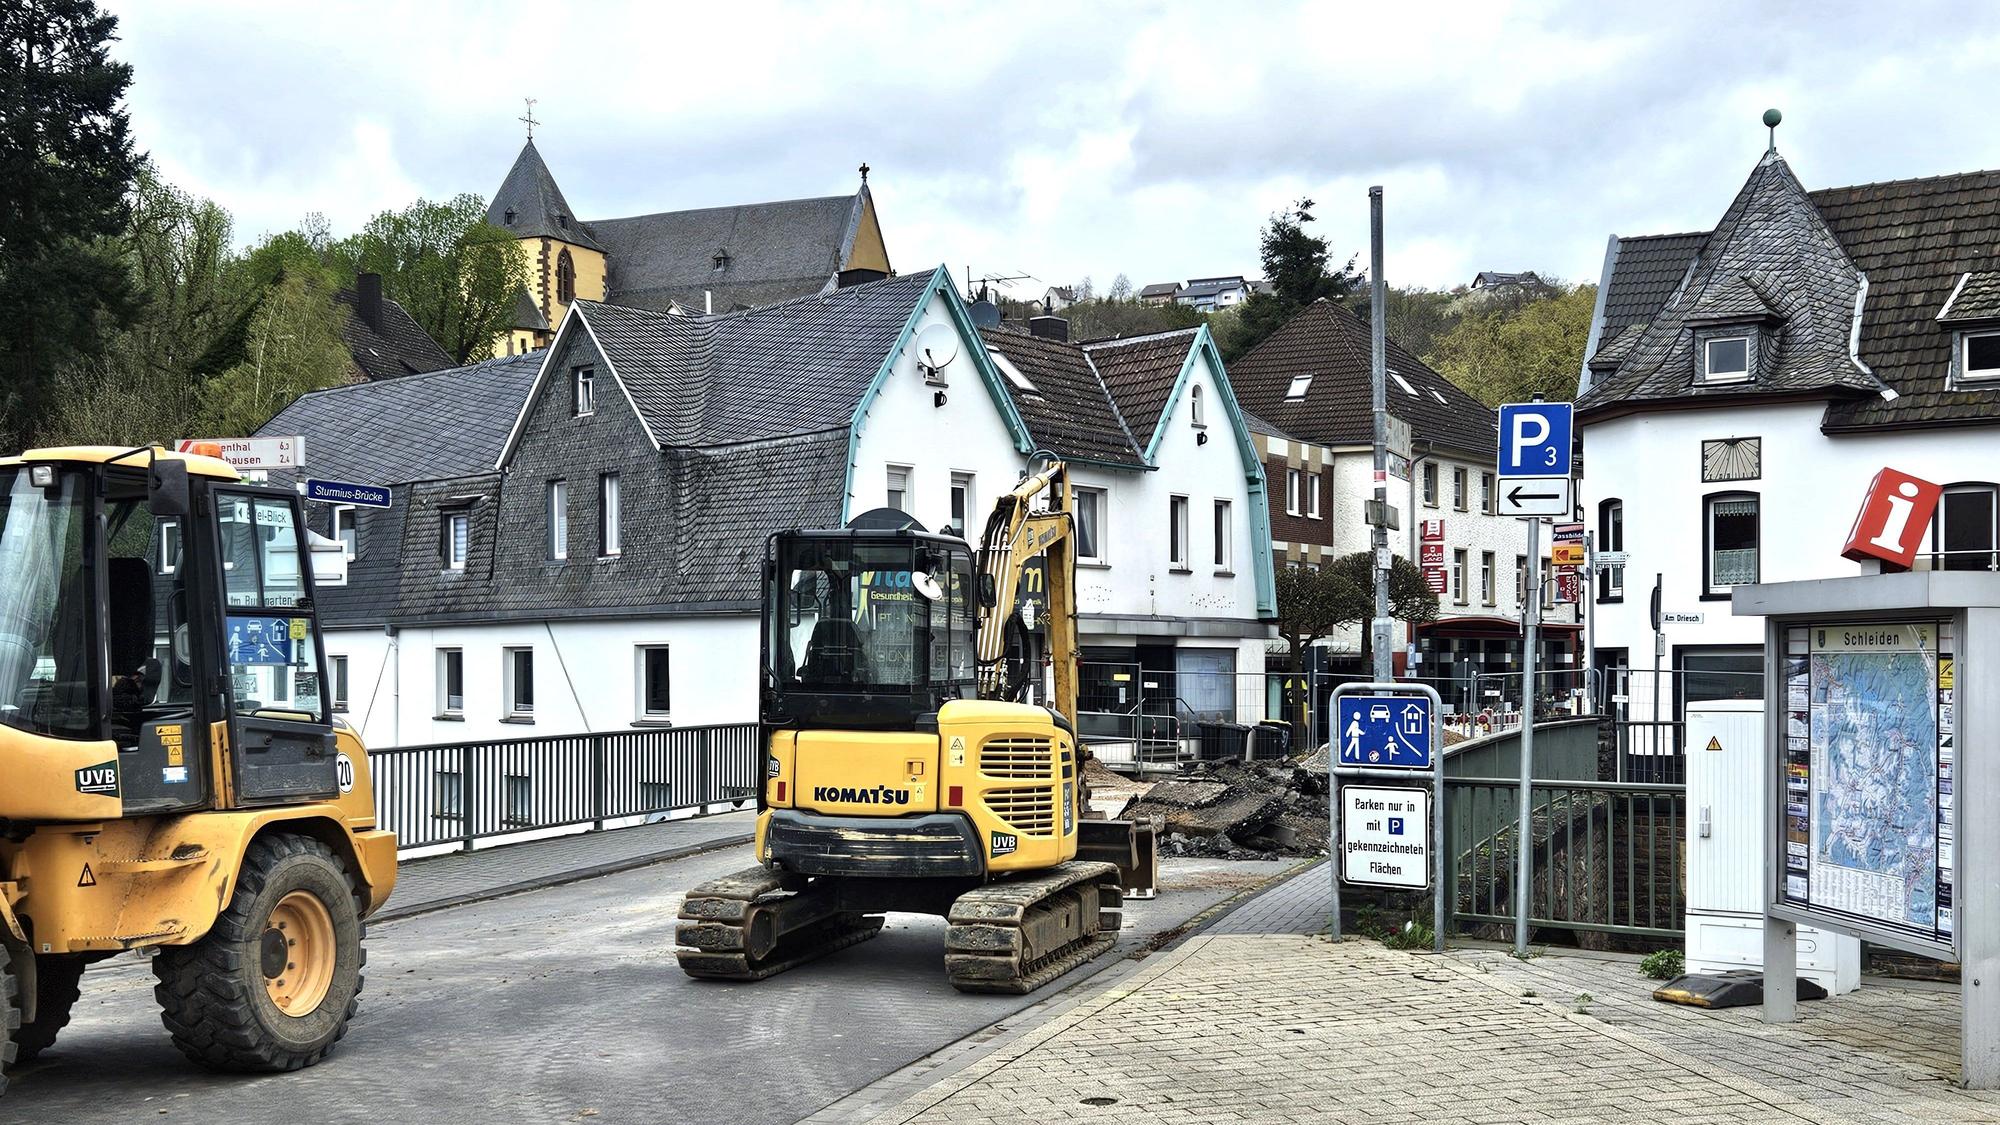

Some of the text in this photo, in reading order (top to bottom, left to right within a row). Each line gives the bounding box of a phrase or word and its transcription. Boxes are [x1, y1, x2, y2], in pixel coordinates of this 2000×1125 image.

[221, 442, 251, 452] enthal
[1512, 413, 1557, 467] P 3
[223, 456, 261, 465] hausen
[314, 485, 384, 502] Sturmius-Brücke
[1677, 614, 1700, 622] Driesch
[1844, 632, 1900, 646] Schleiden
[79, 769, 116, 785] UVB
[337, 760, 352, 787] 20
[814, 785, 909, 804] KOMATSU
[1355, 798, 1415, 812] Parken nur in
[1366, 819, 1381, 831] mit
[993, 836, 1016, 848] UVB
[1348, 840, 1424, 855] gekennzeichneten
[1370, 861, 1402, 876] Flächen
